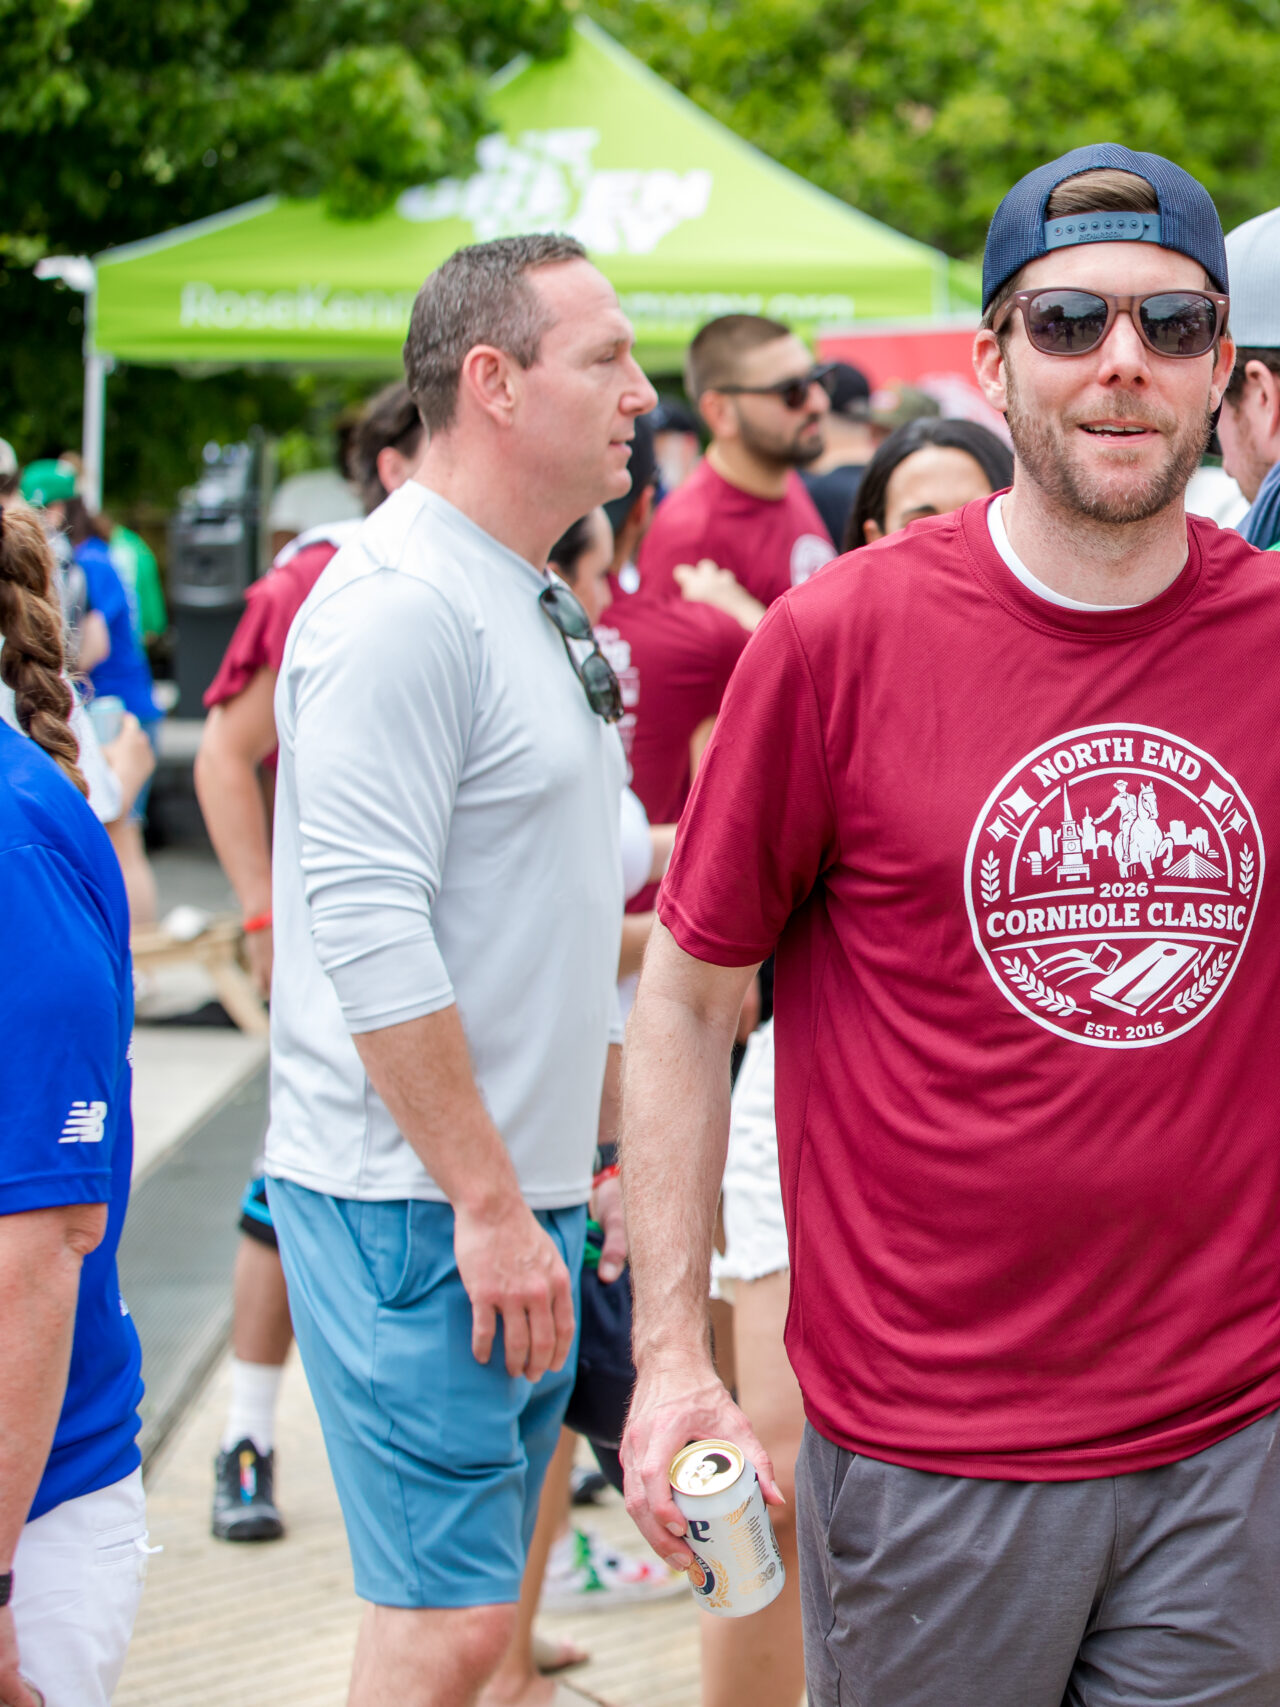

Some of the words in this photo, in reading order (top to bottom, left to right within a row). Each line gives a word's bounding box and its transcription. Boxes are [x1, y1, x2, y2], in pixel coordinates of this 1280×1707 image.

[1031, 738, 1134, 788] NORTH
[1141, 740, 1202, 781] END
[1099, 882, 1149, 898] 2026
[986, 903, 1140, 938] CORNHOLE
[1147, 902, 1247, 931] CLASSIC
[1083, 1022, 1121, 1040] EST.
[1126, 1022, 1165, 1040] 2016
